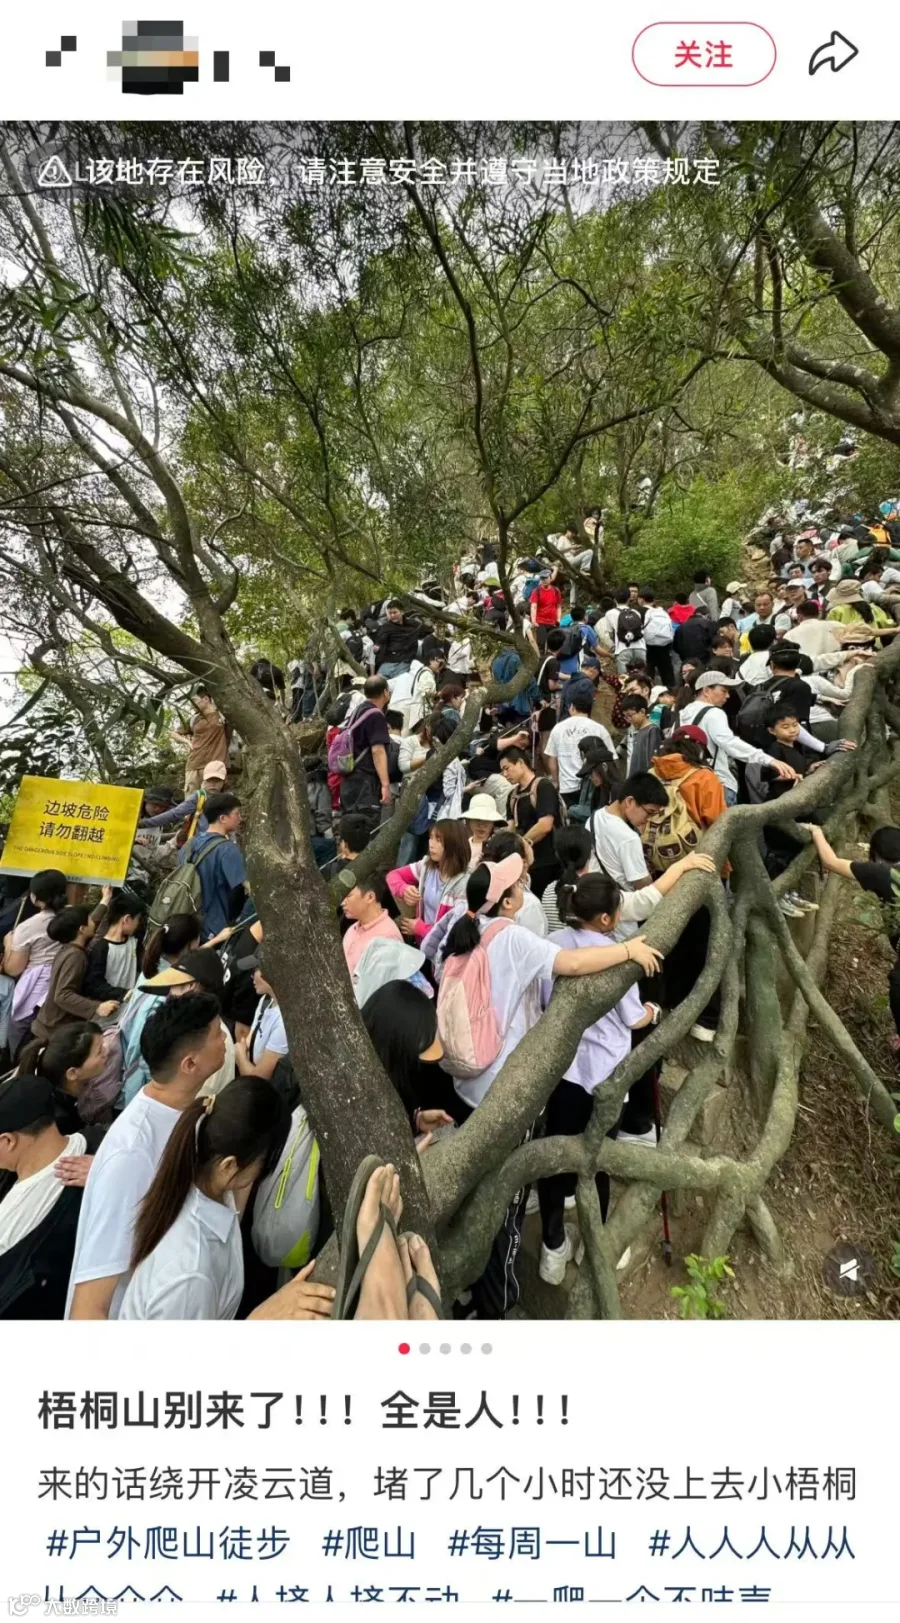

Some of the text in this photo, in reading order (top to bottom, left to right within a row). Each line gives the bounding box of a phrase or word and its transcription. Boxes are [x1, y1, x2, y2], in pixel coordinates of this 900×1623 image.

[43, 800, 110, 821] 边坡危险
[39, 821, 105, 843] 请勿翻越
[67, 851, 84, 859] SLOPE
